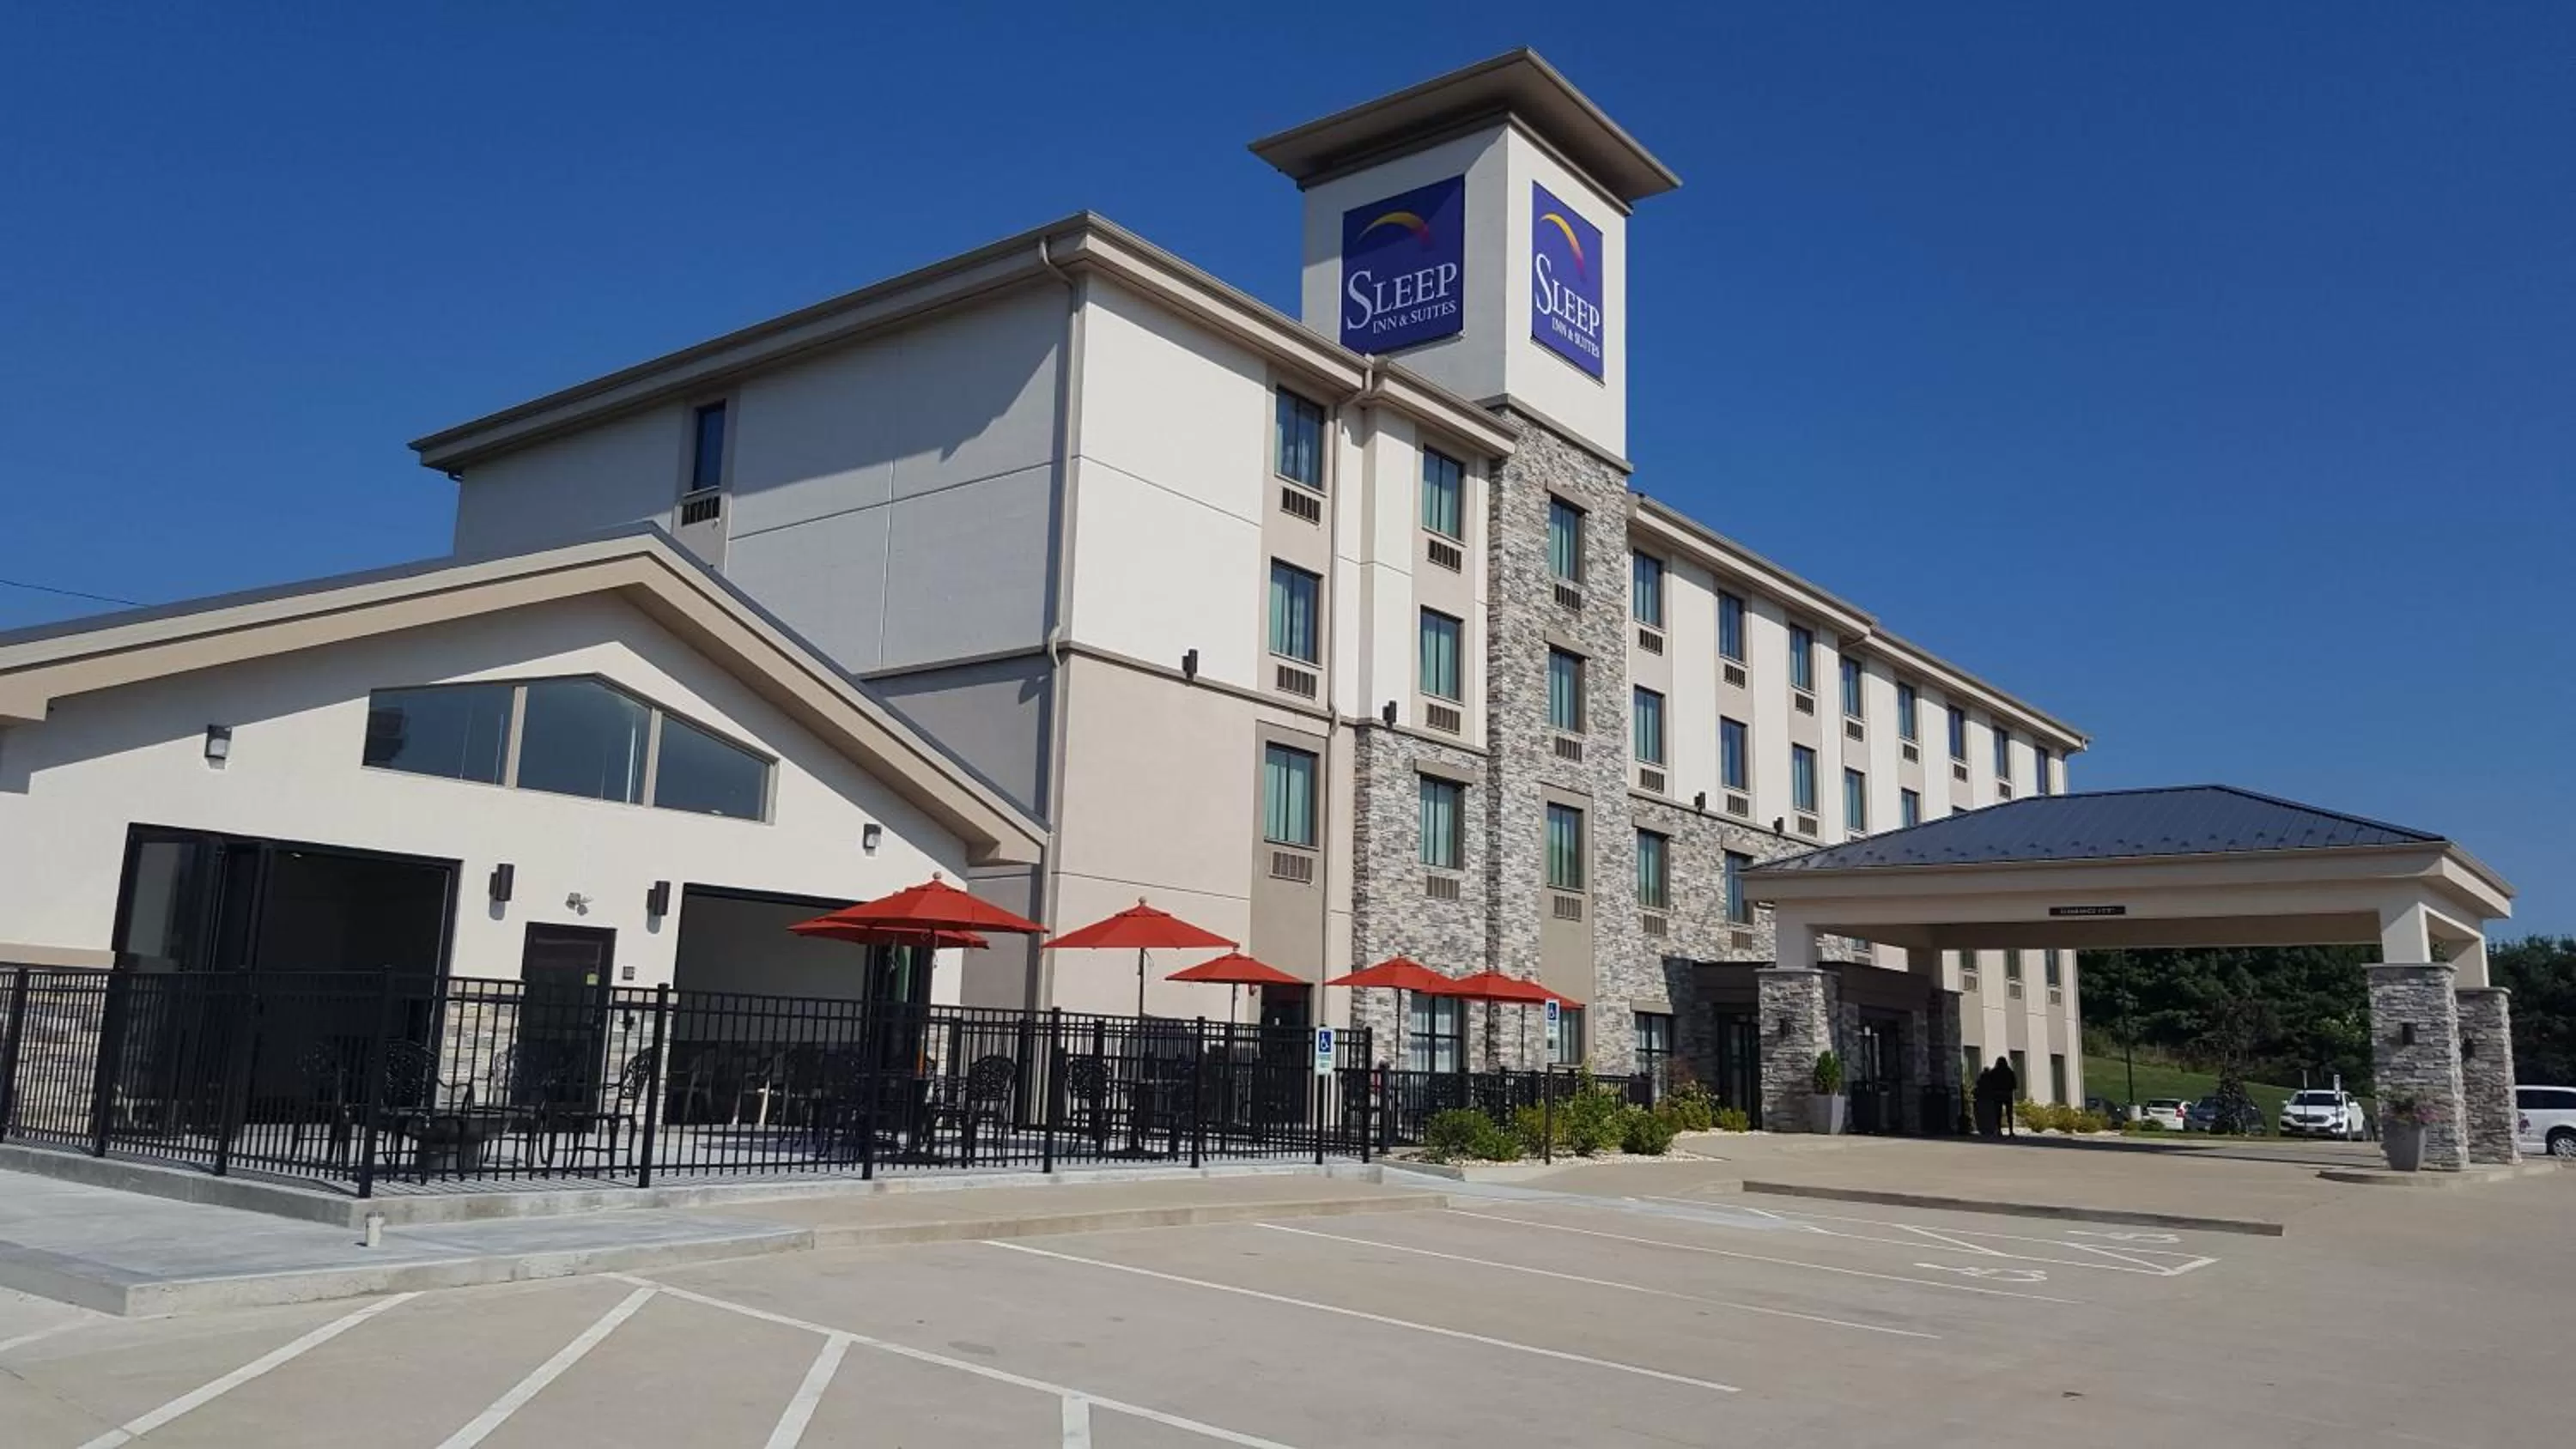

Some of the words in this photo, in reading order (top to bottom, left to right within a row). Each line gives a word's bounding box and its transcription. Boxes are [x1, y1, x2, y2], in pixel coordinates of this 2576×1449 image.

[1346, 261, 1457, 330] SLEEP
[1373, 313, 1398, 334] INN
[1399, 312, 1409, 328] &
[1408, 300, 1457, 324] SUITES
[1535, 252, 1600, 338] SLEEP
[1574, 331, 1600, 359] SUITES
